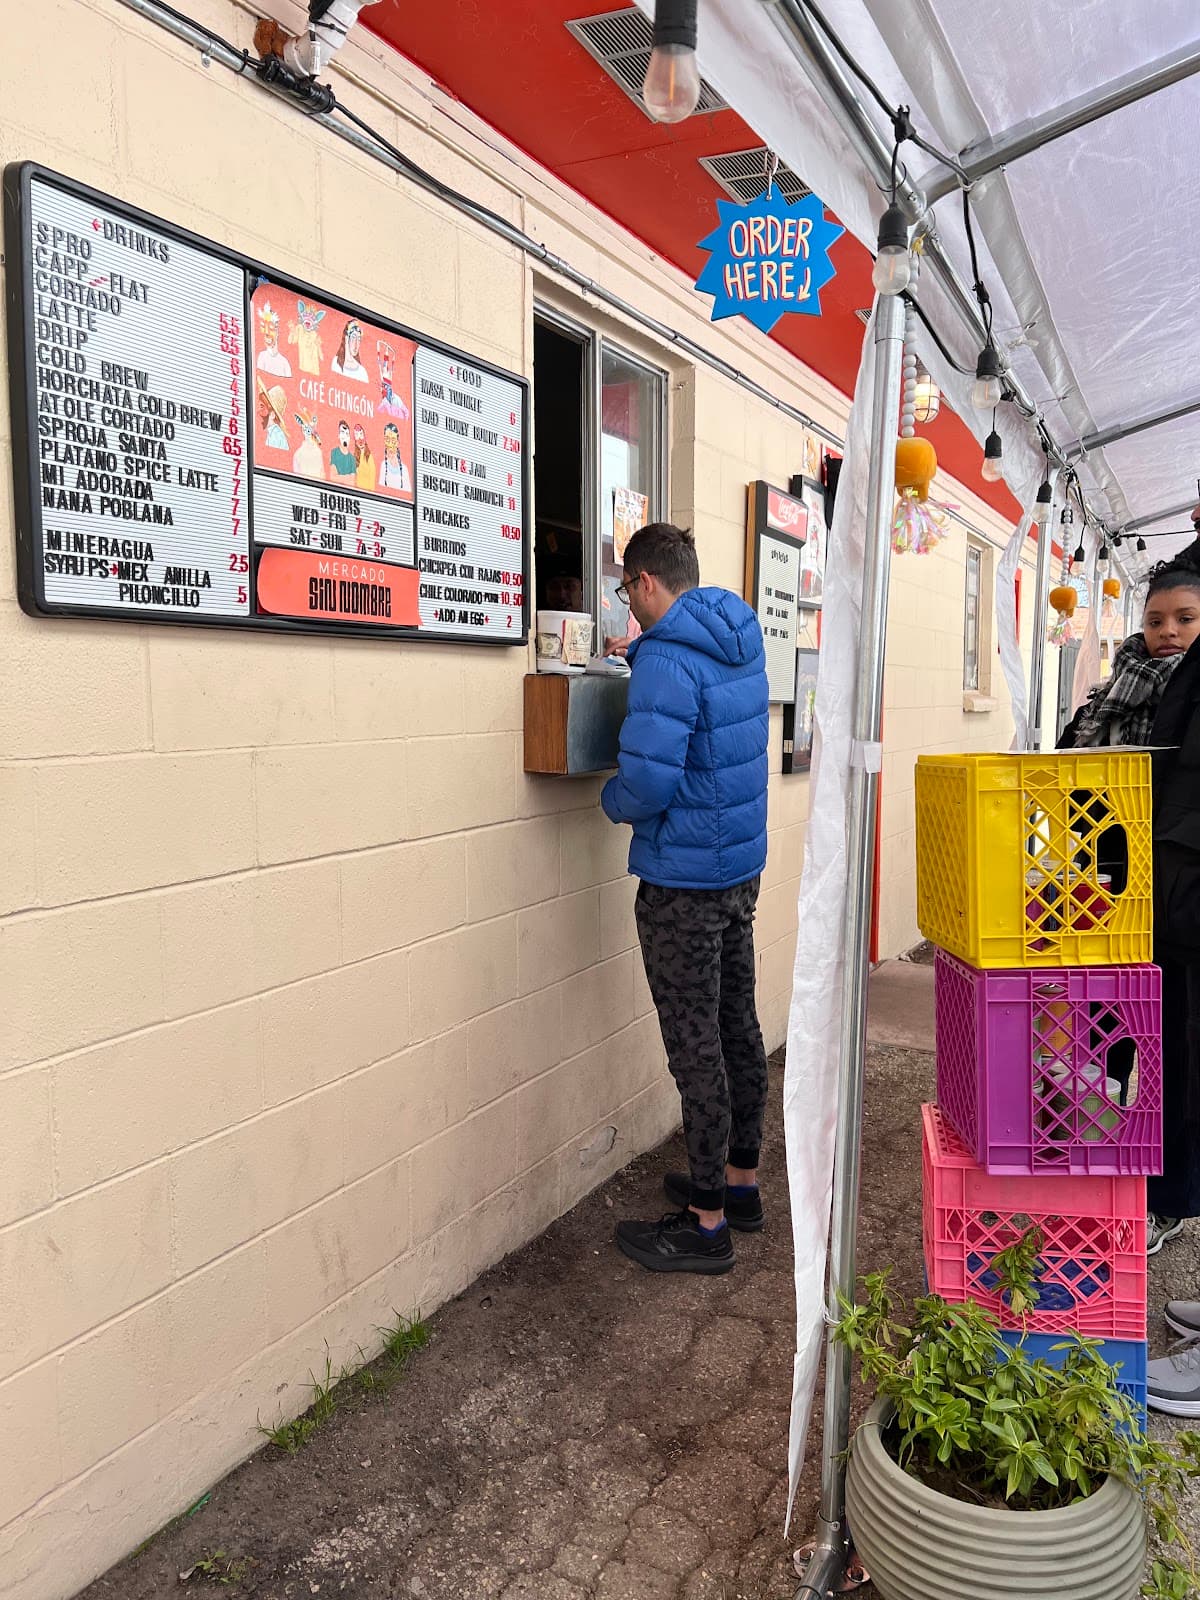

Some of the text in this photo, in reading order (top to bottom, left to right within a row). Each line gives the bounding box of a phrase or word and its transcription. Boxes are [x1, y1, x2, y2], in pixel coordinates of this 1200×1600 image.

[36, 221, 92, 260] SPRO
[103, 218, 170, 264] DRINKS
[728, 214, 813, 261] ORDER
[35, 245, 89, 281] CAPP
[110, 272, 151, 304] FLAT
[722, 260, 795, 303] HERE
[35, 270, 122, 317] CORTADO
[37, 294, 98, 333] LATTE
[37, 318, 89, 351] DRIP
[37, 343, 149, 391] COLD BREW
[229, 357, 241, 376] 6
[456, 366, 481, 388] FOOD
[37, 366, 222, 432] HORCHATA COLD BREW
[229, 378, 239, 396] 4
[299, 378, 375, 418] CAFÉ CHINGÓN
[420, 377, 444, 400] MASA
[39, 391, 176, 442] ATOLE CORTADO
[231, 398, 240, 417] 5
[421, 407, 439, 426] BAD
[509, 411, 516, 425] 6
[38, 414, 168, 461] SPROJA SANTA
[228, 417, 239, 436] 6
[41, 438, 220, 493] PLATANO SPICE LATTE
[232, 458, 242, 477] 7
[468, 461, 486, 478] JAM
[42, 462, 154, 502] MI ADORADA
[231, 478, 241, 497] 7
[422, 474, 504, 507] BISCUIT SANDWICH
[43, 486, 174, 527] NANA POBLANA
[230, 497, 241, 516] 7
[319, 491, 362, 517] HOURS
[507, 496, 515, 510] 11
[231, 518, 241, 536] 7
[423, 506, 470, 529] PANCAKES
[47, 529, 155, 562] MINERAGUA
[423, 535, 466, 556] BURRITOS
[44, 552, 212, 589] SYRUPS MEX ANILLA
[318, 561, 386, 583] MERCADO
[418, 557, 457, 577] CHICKPEA
[459, 564, 474, 579] CON
[477, 567, 501, 584] RAJAS
[118, 583, 201, 608] PILONCILLO
[236, 586, 248, 604] 5
[419, 583, 442, 599] CHILE
[443, 586, 482, 604] COLORADO
[438, 608, 484, 625] ADD AN EGG
[506, 615, 511, 627] 2
